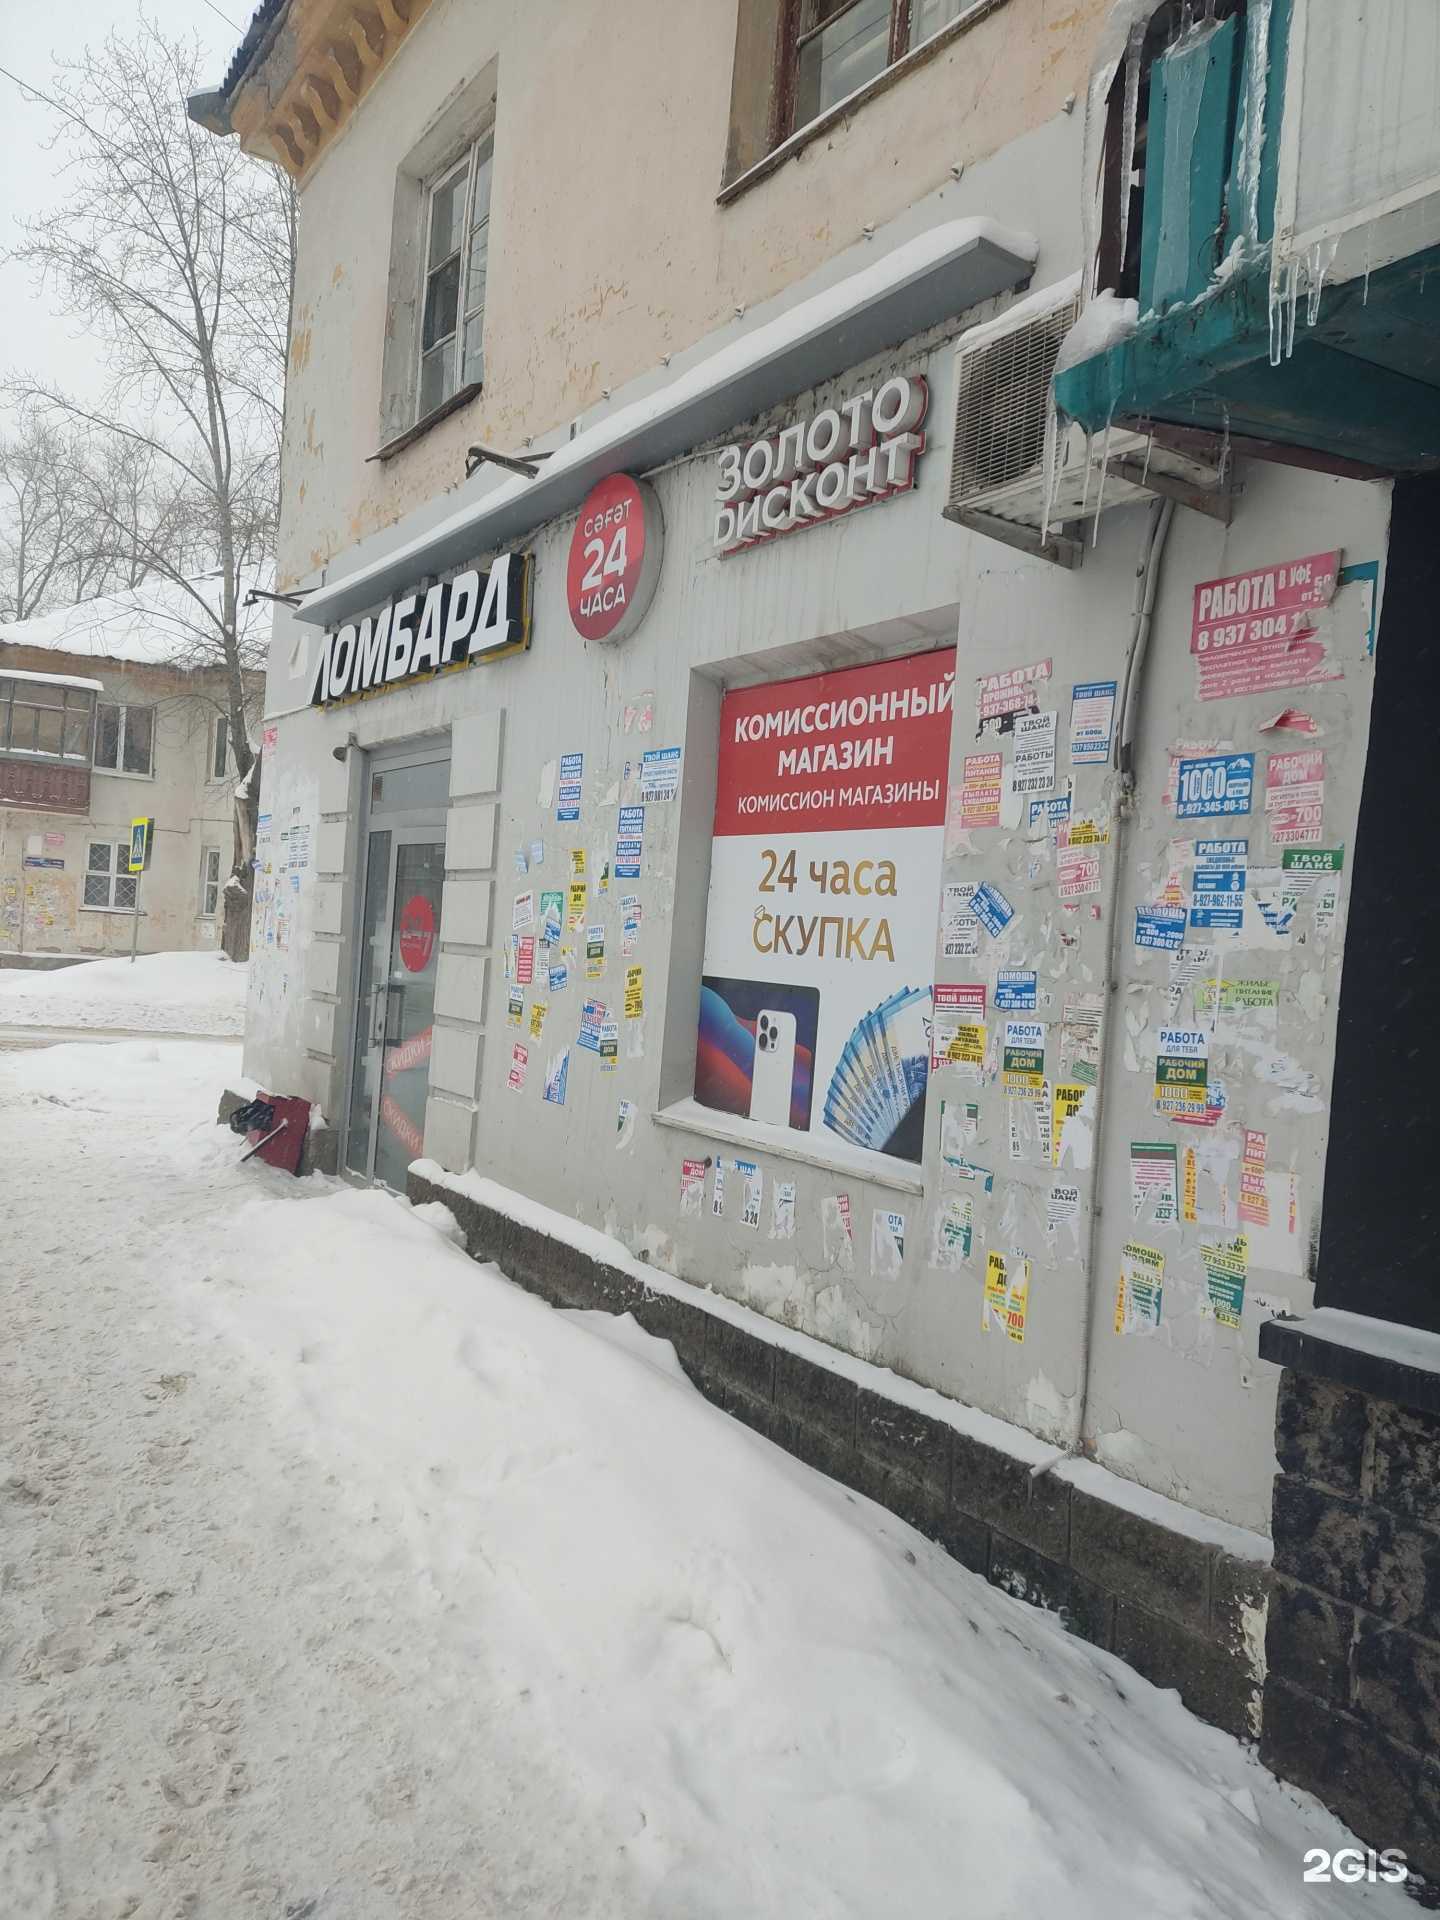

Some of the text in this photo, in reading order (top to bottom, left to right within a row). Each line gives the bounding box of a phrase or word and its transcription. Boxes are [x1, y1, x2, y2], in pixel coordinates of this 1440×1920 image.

[714, 376, 912, 501] ЗОЛОТО
[581, 526, 627, 591] 24
[580, 583, 626, 617] ЧАСА
[1199, 563, 1312, 623] РАБОТА В УФЕ
[306, 552, 511, 706] ЛОМБАРД
[1197, 631, 1209, 651] 8
[1213, 623, 1246, 647] 937
[1250, 615, 1287, 641] 304
[734, 671, 955, 743] КОМИССИОННЫЙ
[1021, 721, 1051, 733] ШАНС
[1023, 714, 1050, 727] ТВОЙ
[777, 735, 894, 776] МАГАЗИН
[965, 754, 1000, 766] РАБОТА
[1016, 750, 1053, 763] РАБОТЫ
[1181, 766, 1227, 802] 1000
[737, 779, 940, 814] КОМИССИОН МАГАЗИНЫ
[1296, 806, 1322, 823] 700
[1199, 841, 1246, 854] РАБОТА
[1292, 853, 1333, 862] ТВОЙ
[1079, 862, 1099, 877] 700
[1291, 861, 1334, 869] ШАНС
[758, 849, 898, 896] 24 часа
[947, 885, 974, 893] ТВОЙ
[752, 912, 895, 962] СКУПКА
[998, 972, 1036, 982] ПОМОЩЬ
[936, 993, 983, 1003] ТВОЙ ШАНС
[1007, 1024, 1042, 1037] РАБОТА
[1160, 1031, 1205, 1045] РАБОТА
[1005, 1048, 1043, 1058] РАБОЧИЙ
[1010, 1057, 1036, 1068] ДОМ
[1159, 1058, 1206, 1069] РАБОЧИЙ
[1166, 1068, 1197, 1080] ДОМ
[1161, 1087, 1188, 1099] 1000
[690, 1168, 705, 1177] ДОМ
[750, 1211, 758, 1225] 24
[1125, 1244, 1164, 1261] ОМОЩЬ
[1008, 1311, 1024, 1328] 700
